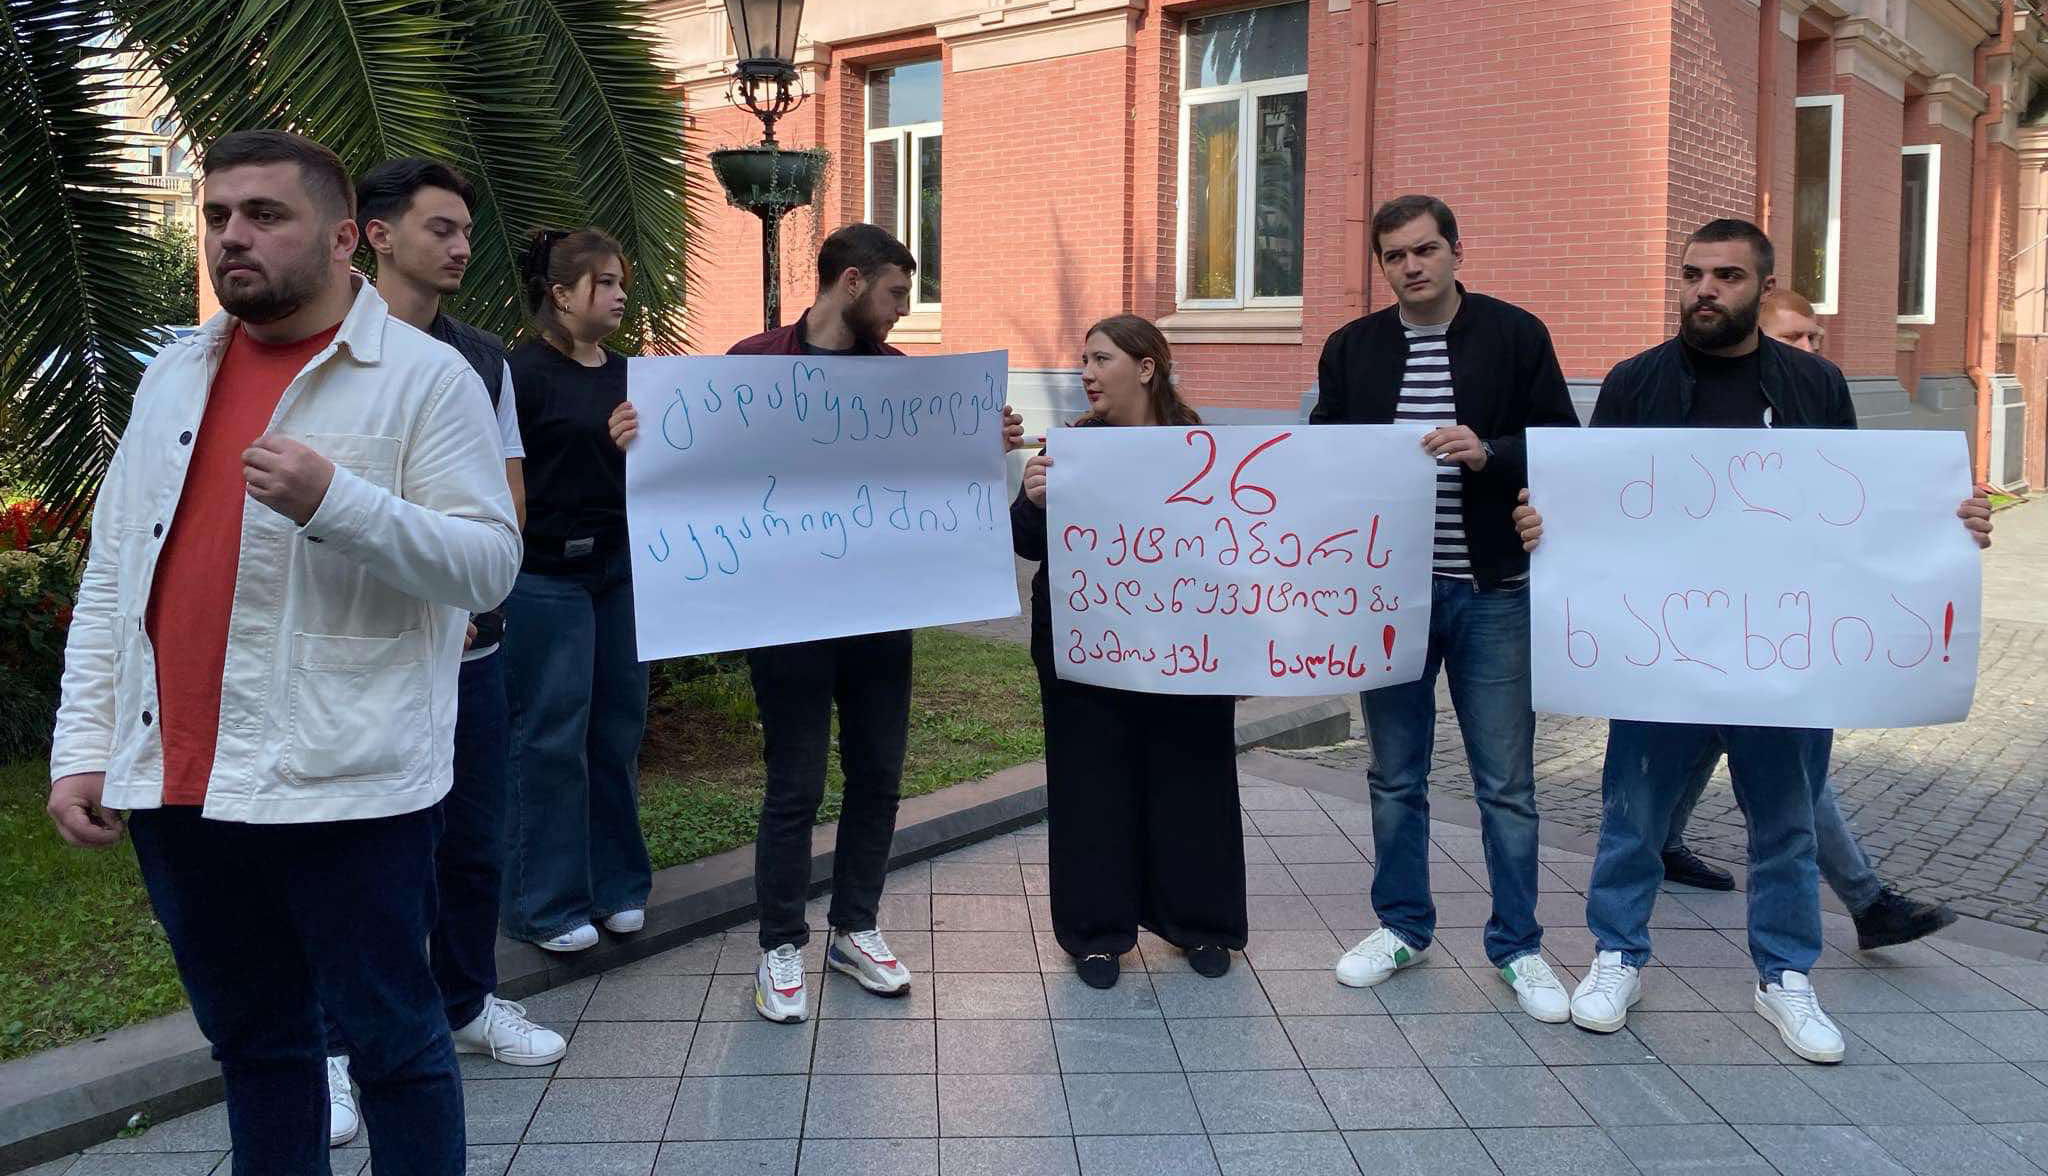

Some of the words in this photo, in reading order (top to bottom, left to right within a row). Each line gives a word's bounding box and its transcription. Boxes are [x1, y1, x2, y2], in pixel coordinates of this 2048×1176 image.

[1163, 430, 1292, 515] 26
[1619, 450, 1866, 526] ძალა
[1063, 514, 1392, 568] ოქტომბერს
[1068, 569, 1400, 617] გადაწყვეტილება
[1068, 629, 1219, 677] გამოაქვს
